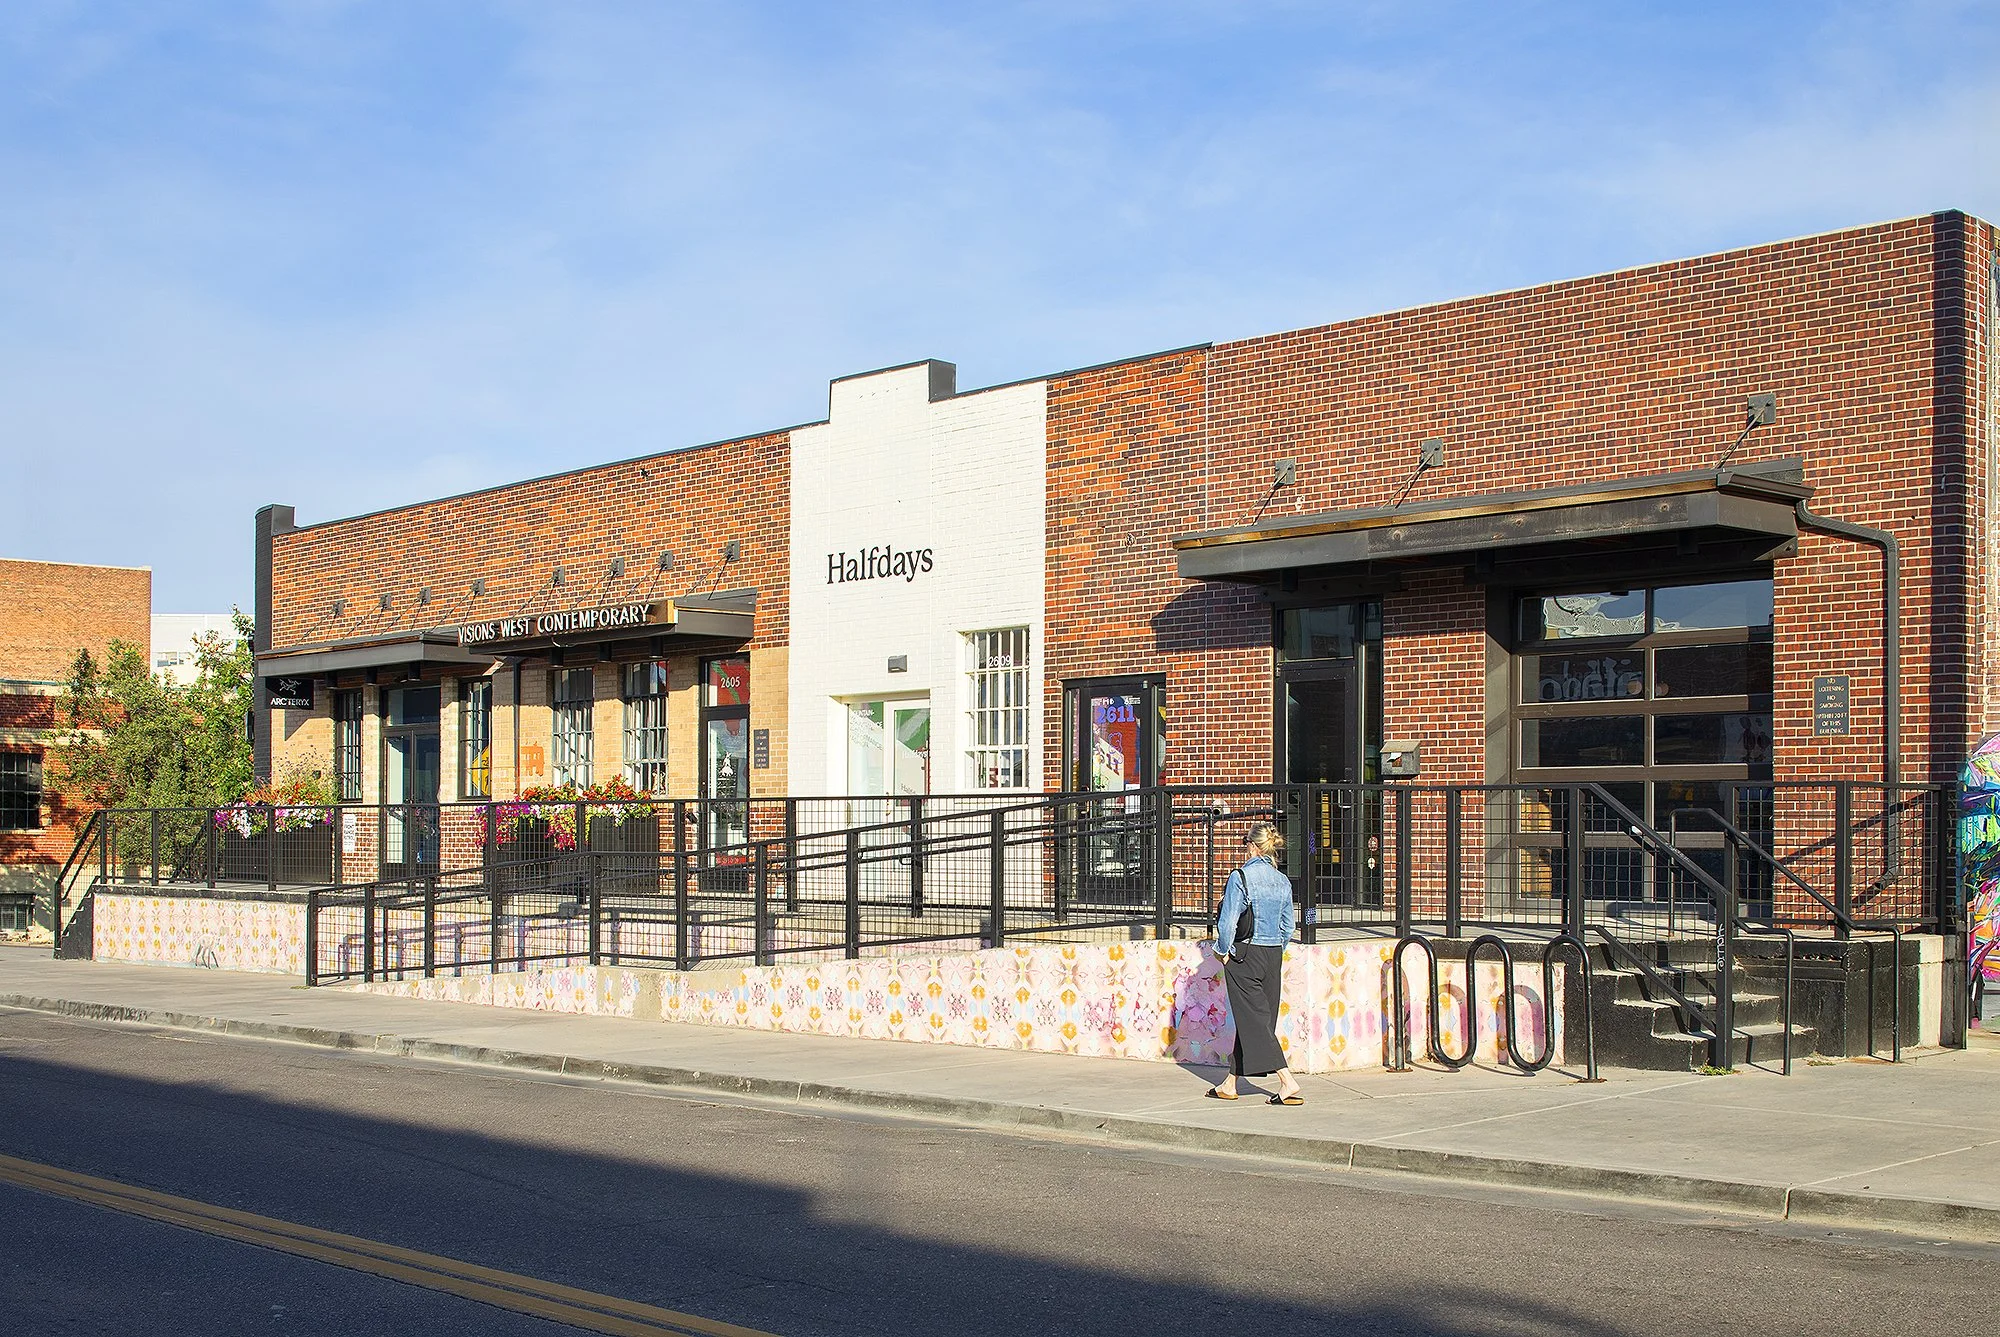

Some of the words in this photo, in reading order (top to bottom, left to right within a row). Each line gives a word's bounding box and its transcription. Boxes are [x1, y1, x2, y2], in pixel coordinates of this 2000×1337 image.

[827, 545, 933, 584] Halfdays
[458, 622, 495, 644] VISIONS
[500, 617, 531, 638] WEST
[536, 604, 650, 632] CONTEMPORARY
[989, 655, 1011, 667] 2609
[720, 676, 741, 689] 2605
[1097, 705, 1135, 723] 2611
